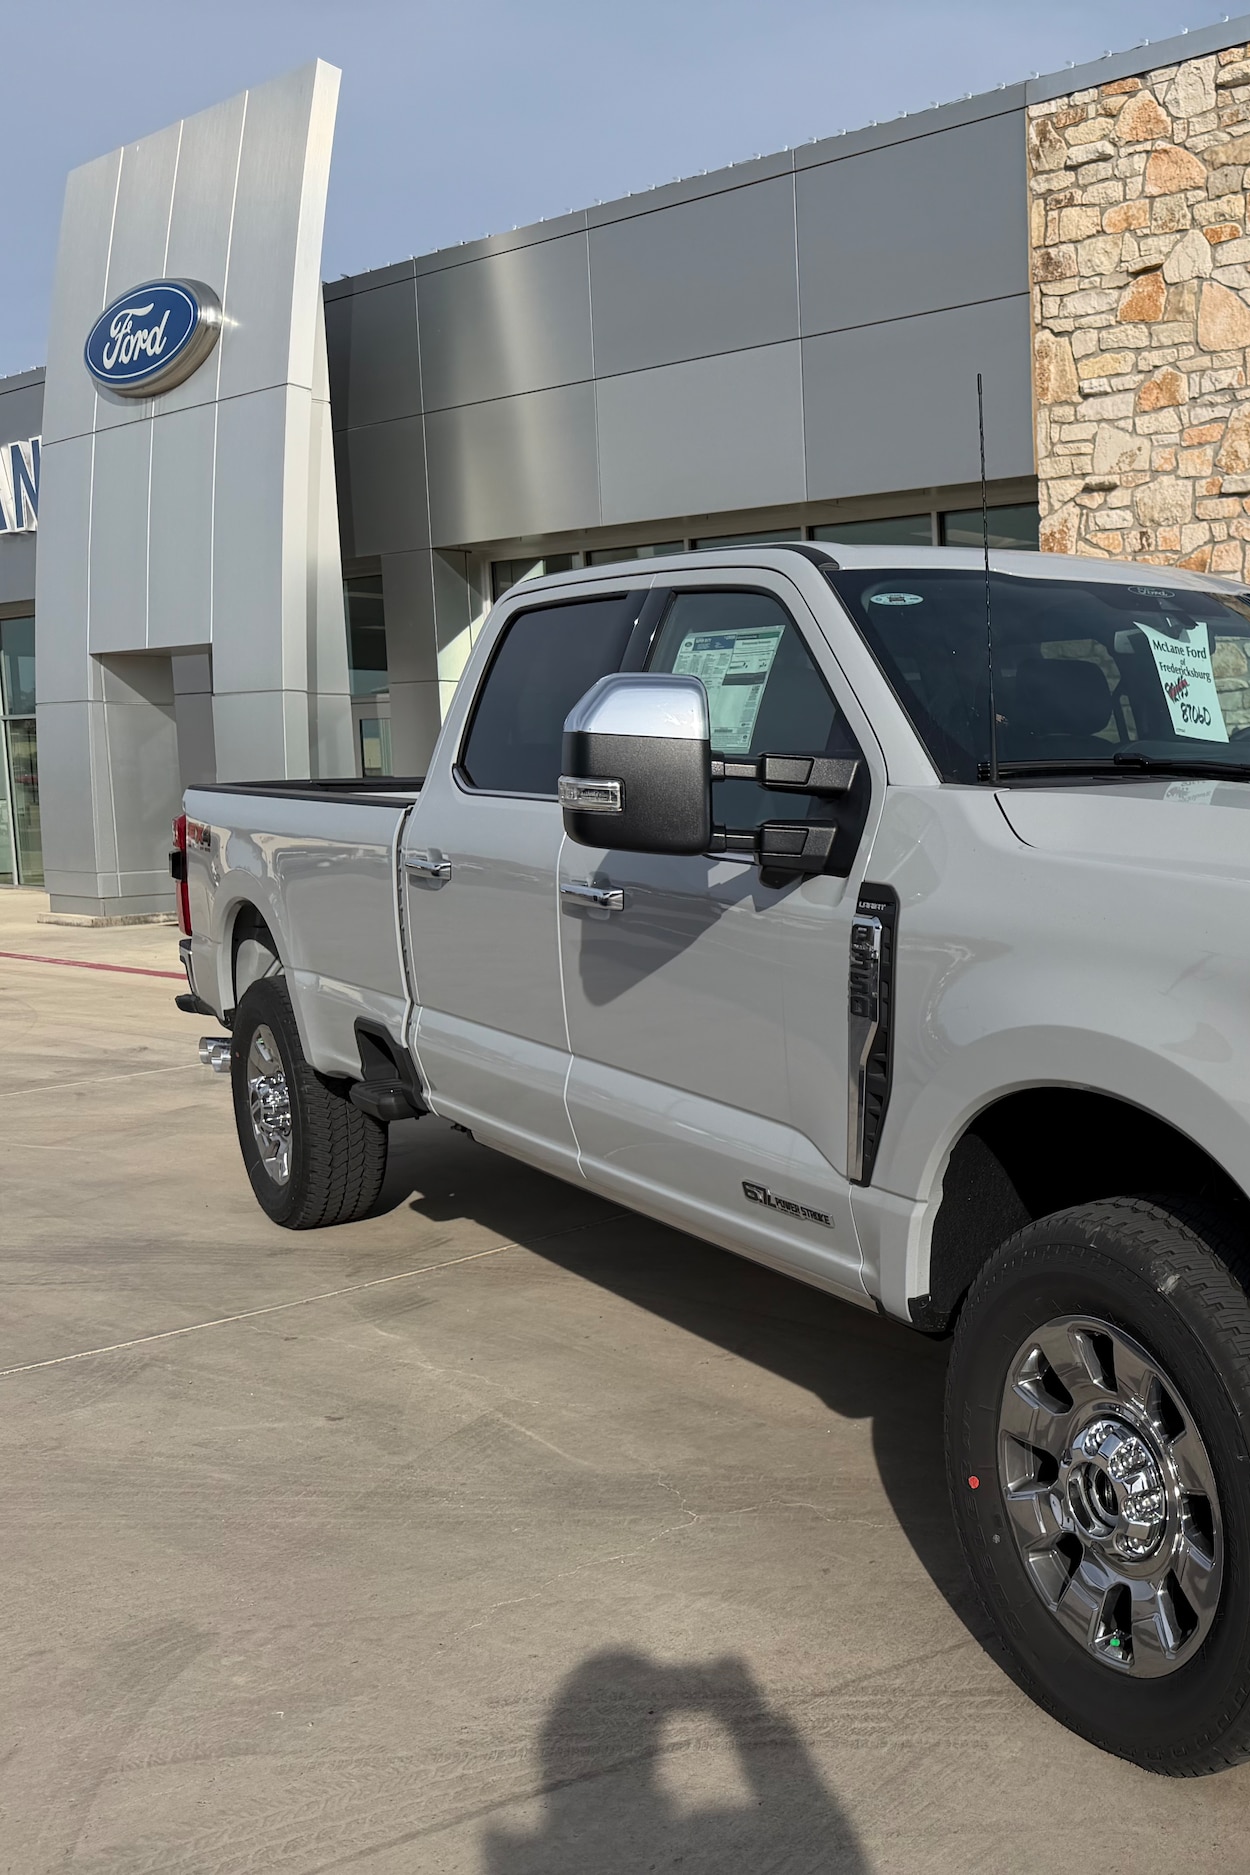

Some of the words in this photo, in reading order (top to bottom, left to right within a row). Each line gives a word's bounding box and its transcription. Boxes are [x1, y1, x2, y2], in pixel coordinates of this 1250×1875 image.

[102, 303, 171, 370] Ford
[0, 434, 42, 534] N
[1152, 640, 1185, 656] McLane
[1186, 646, 1207, 660] Ford
[1158, 661, 1212, 683] Fredericksburg
[775, 1197, 801, 1213] POWER
[800, 1206, 831, 1225] STROKE
